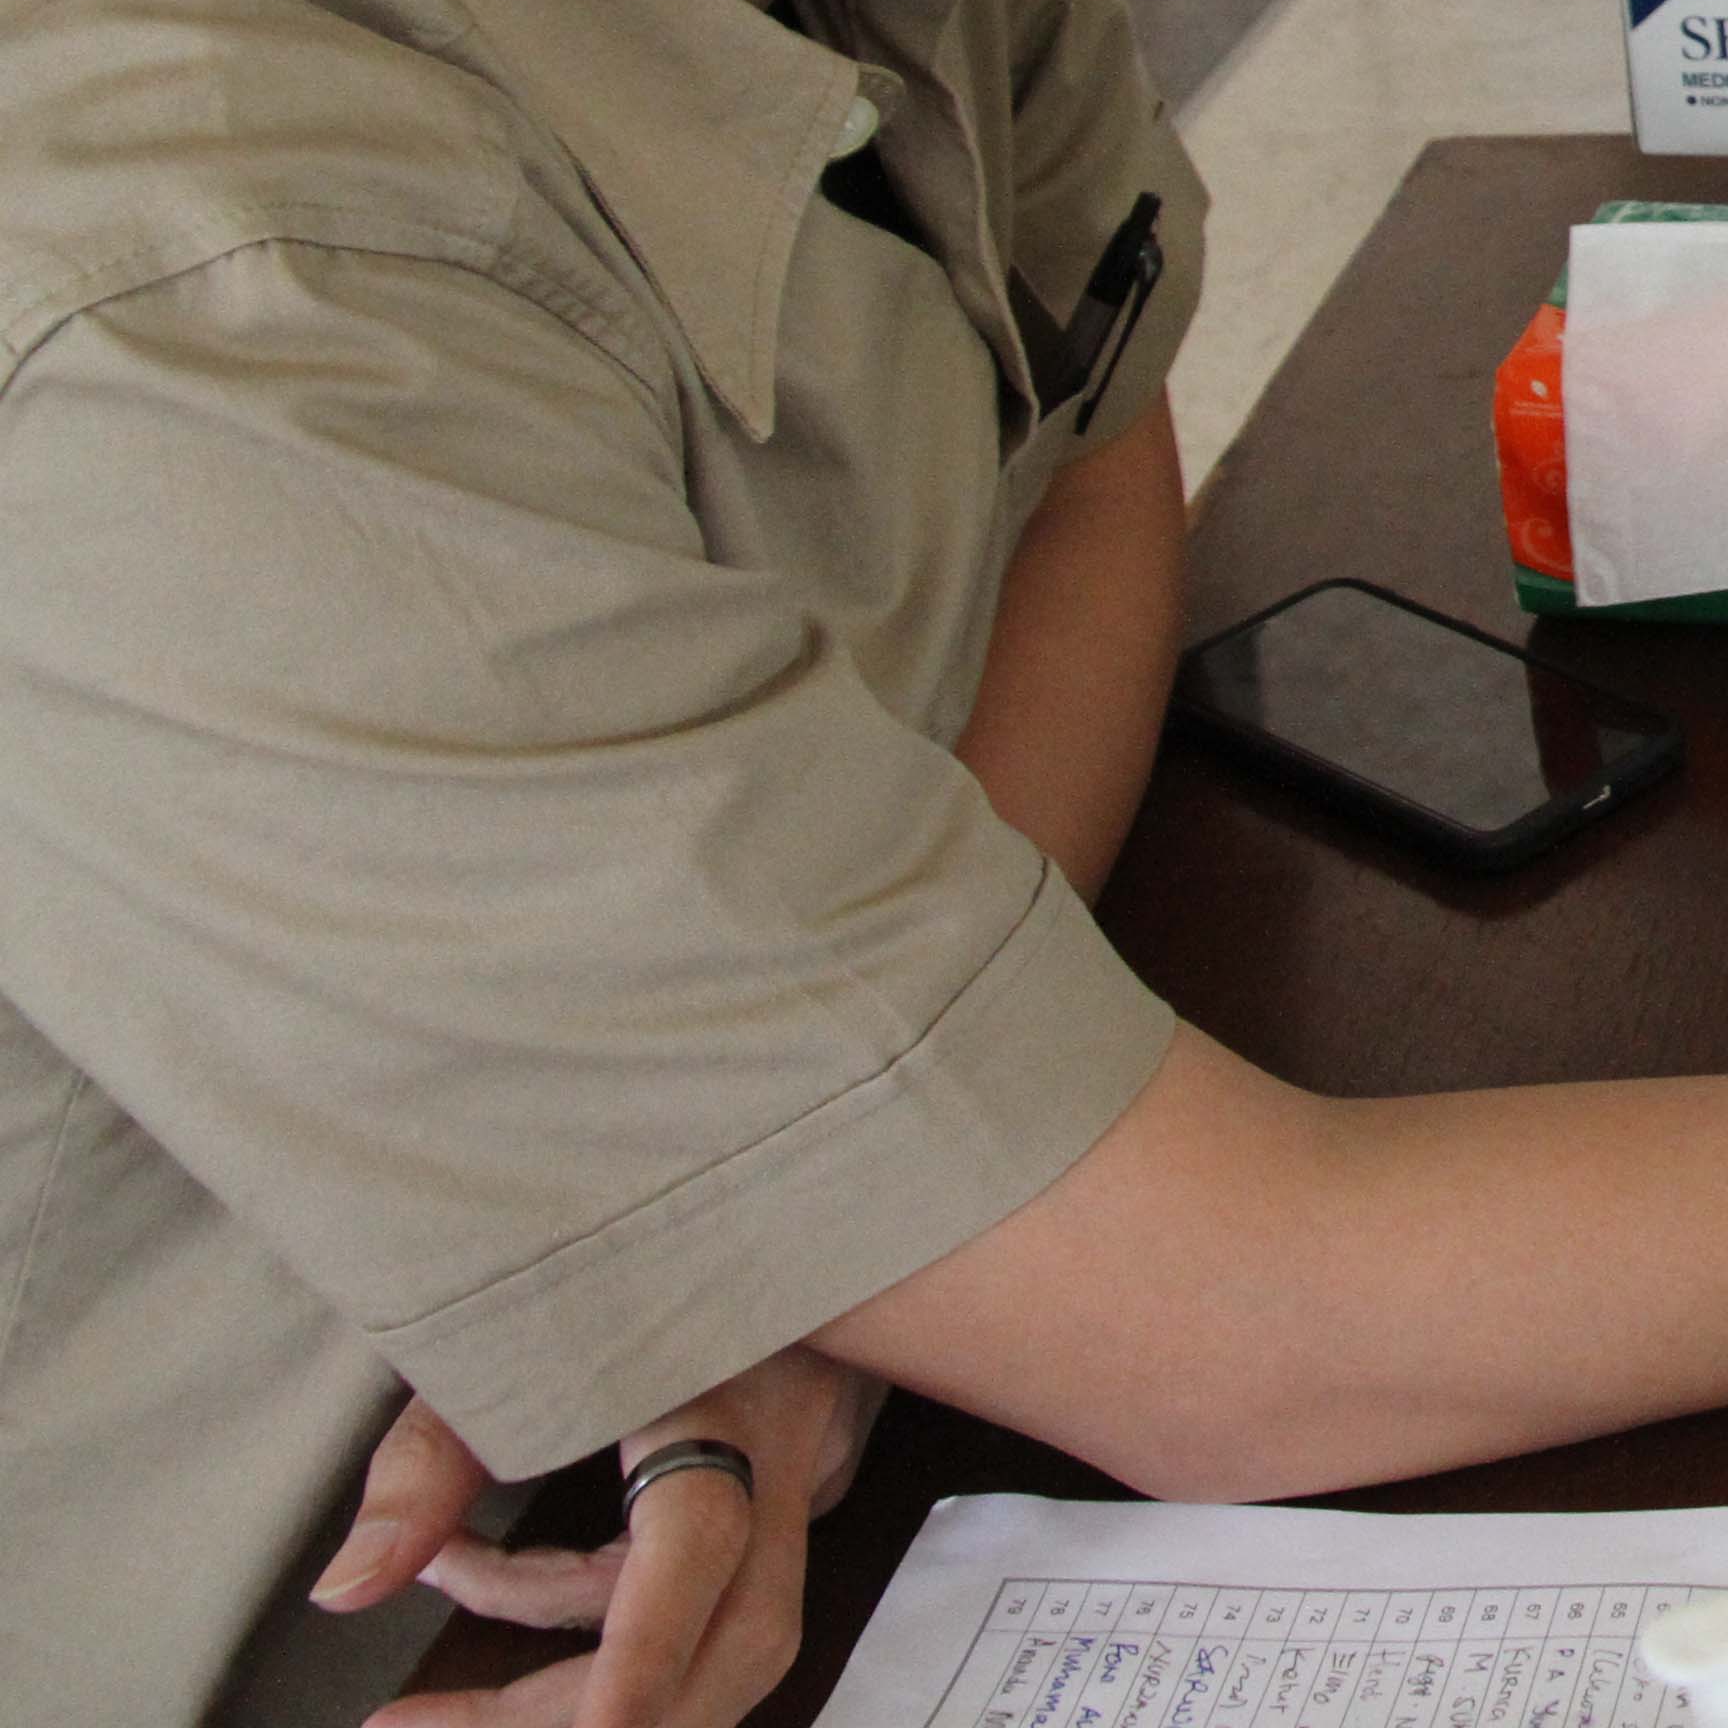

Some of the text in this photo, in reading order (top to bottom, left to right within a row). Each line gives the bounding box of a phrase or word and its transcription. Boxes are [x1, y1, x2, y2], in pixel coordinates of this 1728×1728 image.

[1095, 1601, 1113, 1616] 77
[1179, 1603, 1198, 1619] 75
[1224, 1606, 1242, 1620] 74
[1266, 1607, 1285, 1623] 73
[1309, 1608, 1328, 1624] 72
[1352, 1609, 1370, 1623] 71
[1395, 1608, 1413, 1624] 70
[1481, 1604, 1498, 1621] 68
[1525, 1604, 1542, 1620] 67
[1567, 1602, 1585, 1620] 66
[1610, 1602, 1628, 1619] 65
